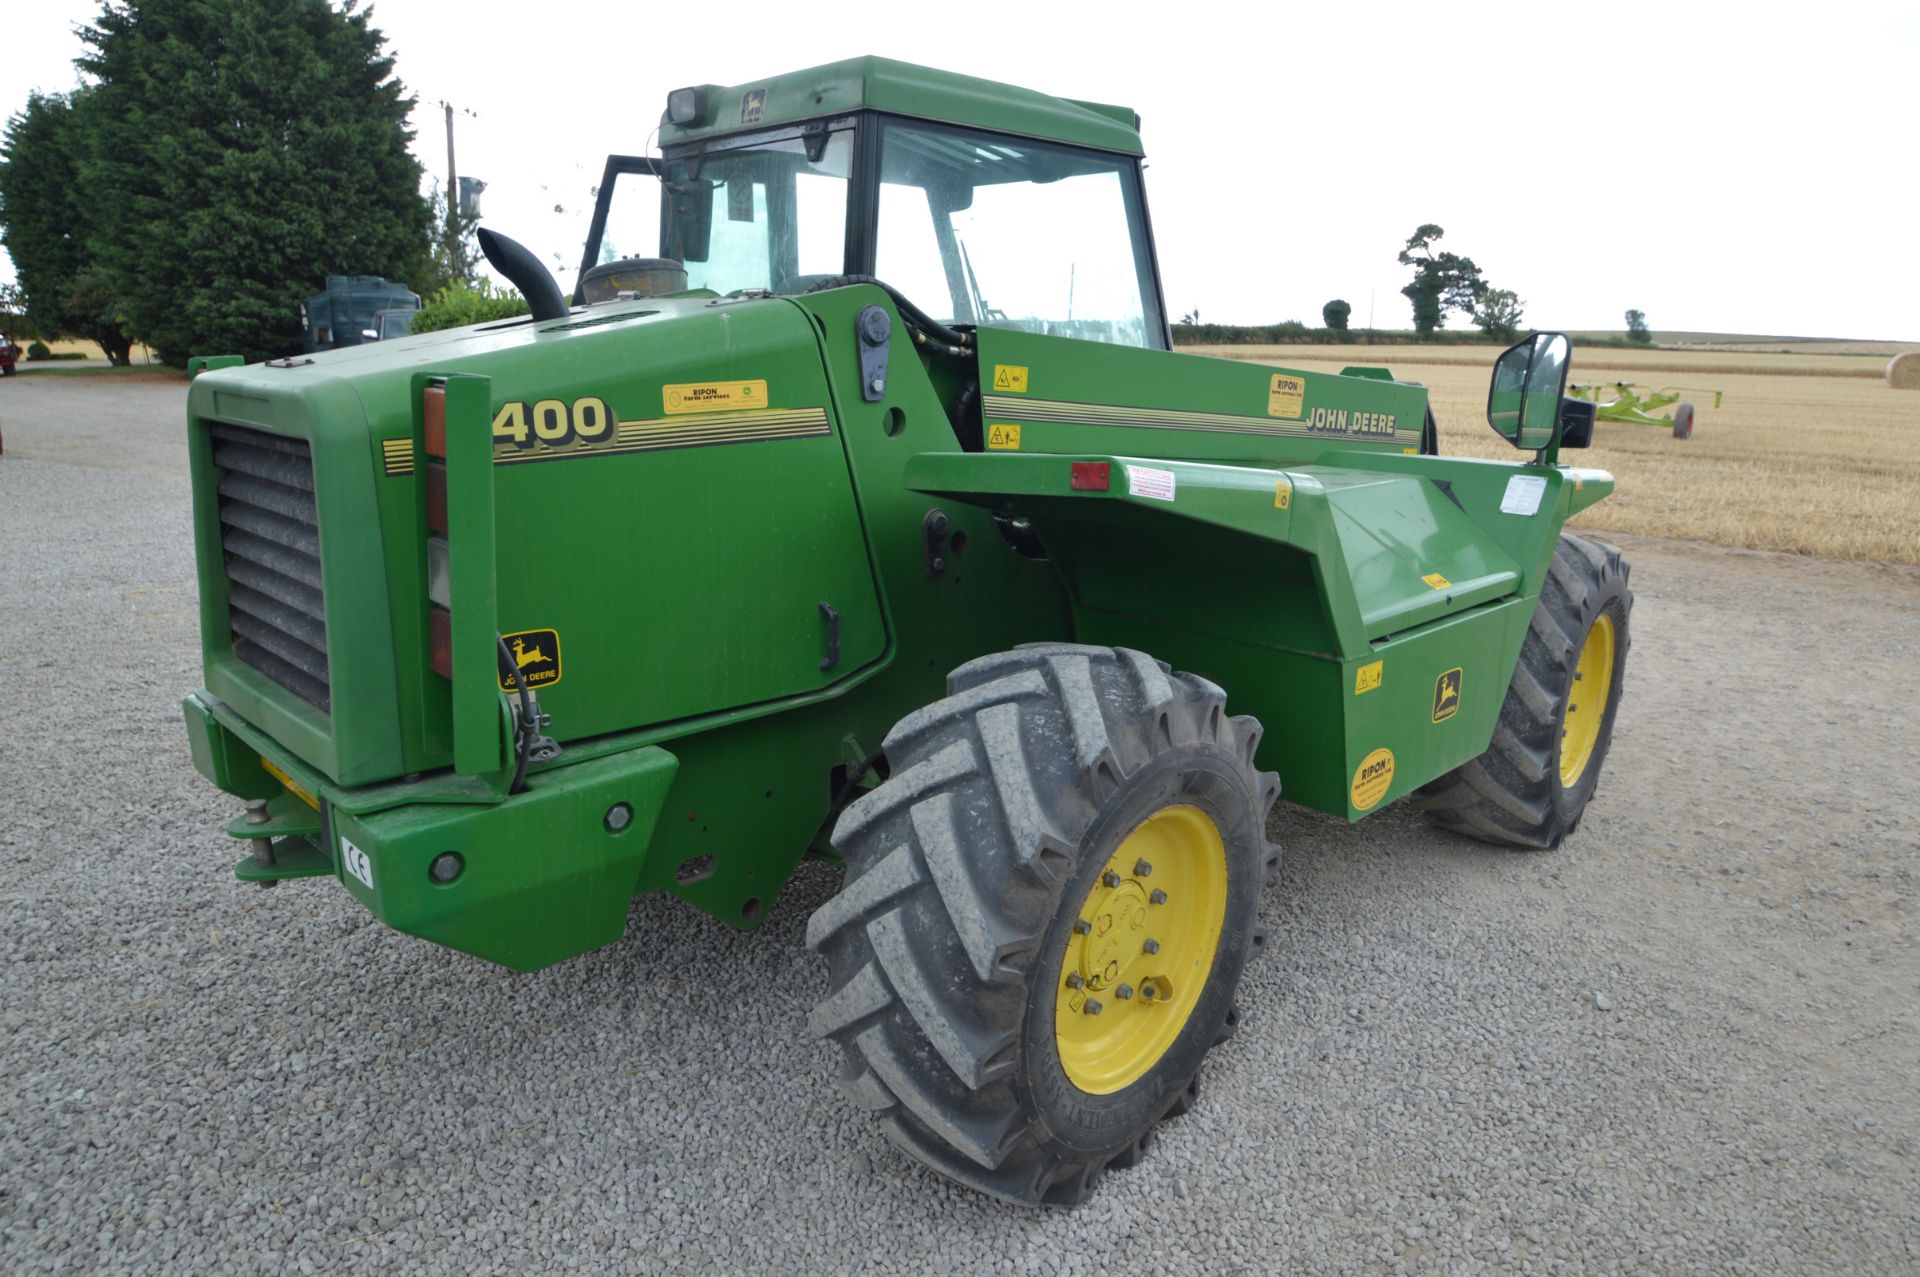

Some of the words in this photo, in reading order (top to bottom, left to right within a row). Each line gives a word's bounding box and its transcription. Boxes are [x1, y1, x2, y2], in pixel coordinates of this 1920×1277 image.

[693, 388, 718, 397] RIPON
[1277, 379, 1298, 391] RIPON
[1306, 407, 1348, 432] JOHN
[1352, 411, 1395, 435] DEERE
[504, 675, 528, 686] JON
[530, 670, 556, 681] DEERE
[1362, 759, 1386, 780] RIPON
